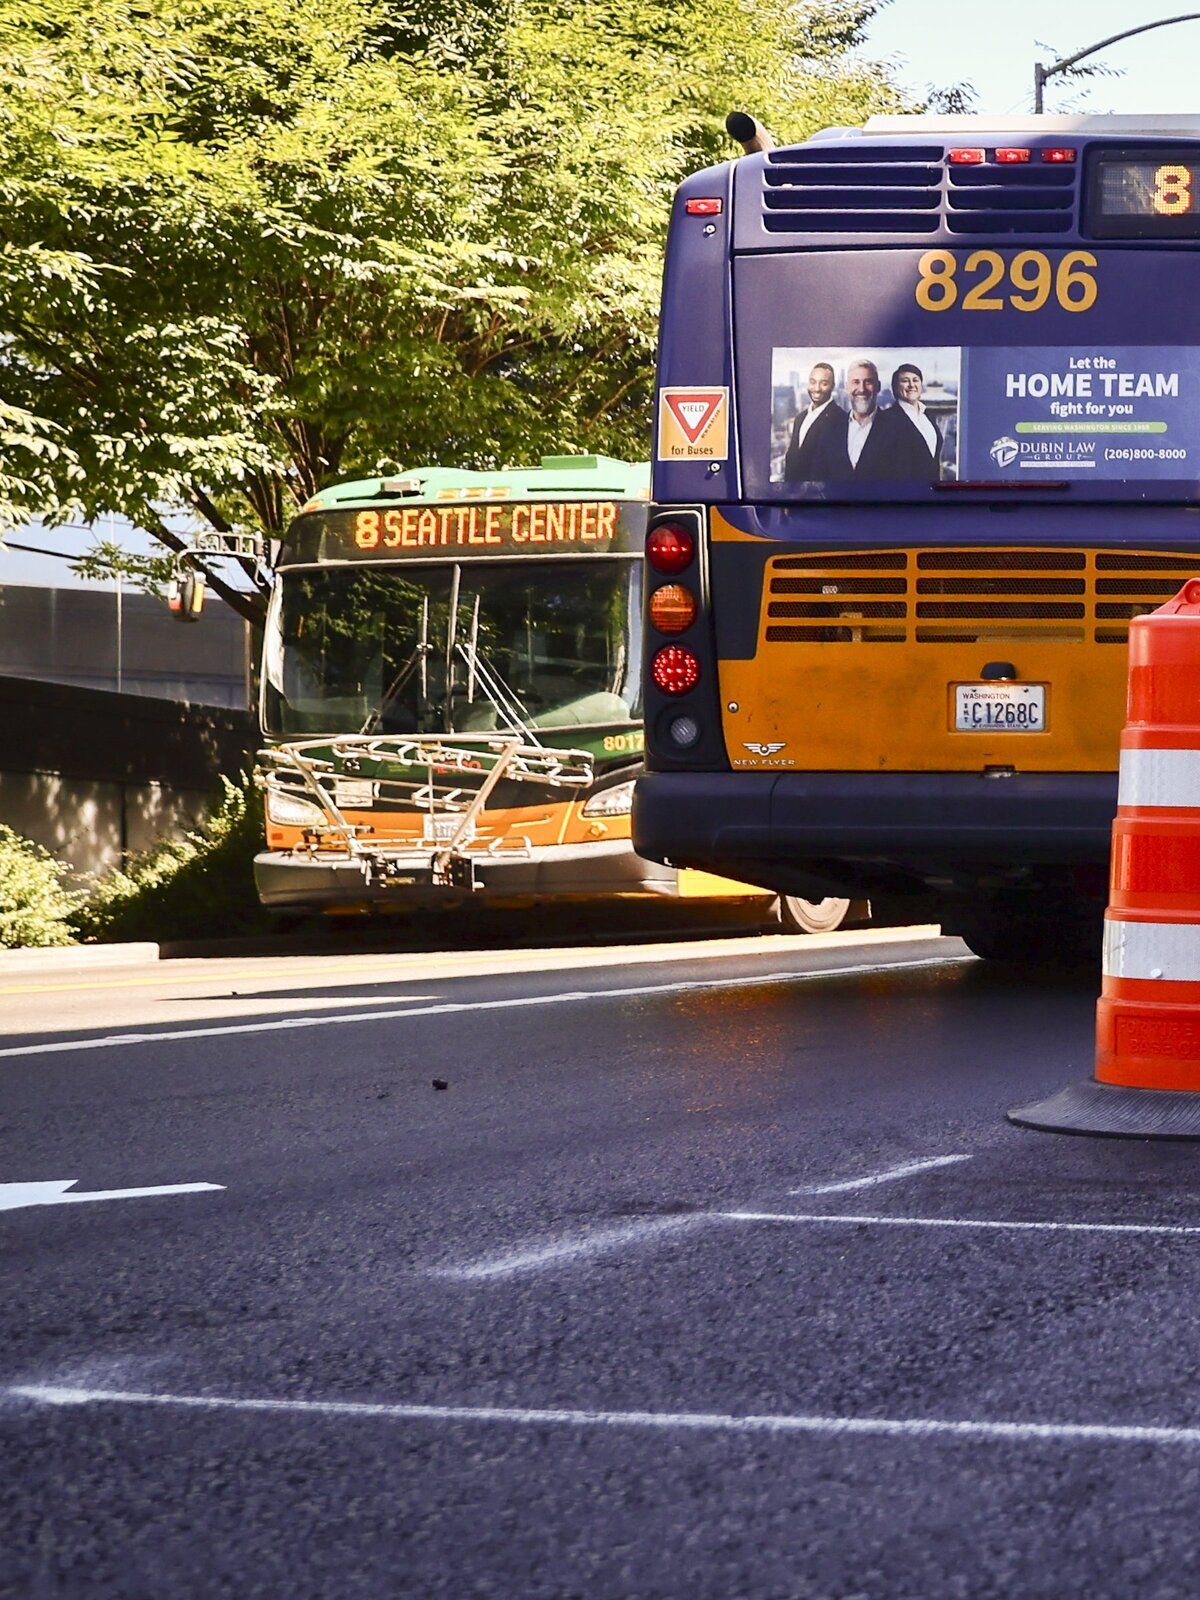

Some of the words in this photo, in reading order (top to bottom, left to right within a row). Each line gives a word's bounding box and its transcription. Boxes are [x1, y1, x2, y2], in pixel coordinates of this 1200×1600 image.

[1153, 165, 1192, 215] 8
[915, 249, 1099, 312] 8296
[1069, 357, 1091, 369] Let
[1093, 356, 1116, 369] the
[1006, 373, 1092, 398] HOME
[1099, 373, 1179, 397] TEAM
[682, 404, 705, 412] YIELD
[1050, 402, 1083, 417] fight
[1085, 402, 1106, 415] for
[1108, 404, 1133, 417] you
[671, 445, 685, 455] for
[687, 445, 714, 455] Buses
[1020, 442, 1064, 453] DUBIN
[1069, 442, 1096, 453] LAW
[1104, 449, 1187, 461] (206)800-8000
[354, 510, 379, 548] 8
[383, 506, 503, 547] SEATTLE
[511, 502, 617, 542] CENTER
[962, 692, 1010, 700] WASHINGTON
[972, 702, 1038, 724] C1268C
